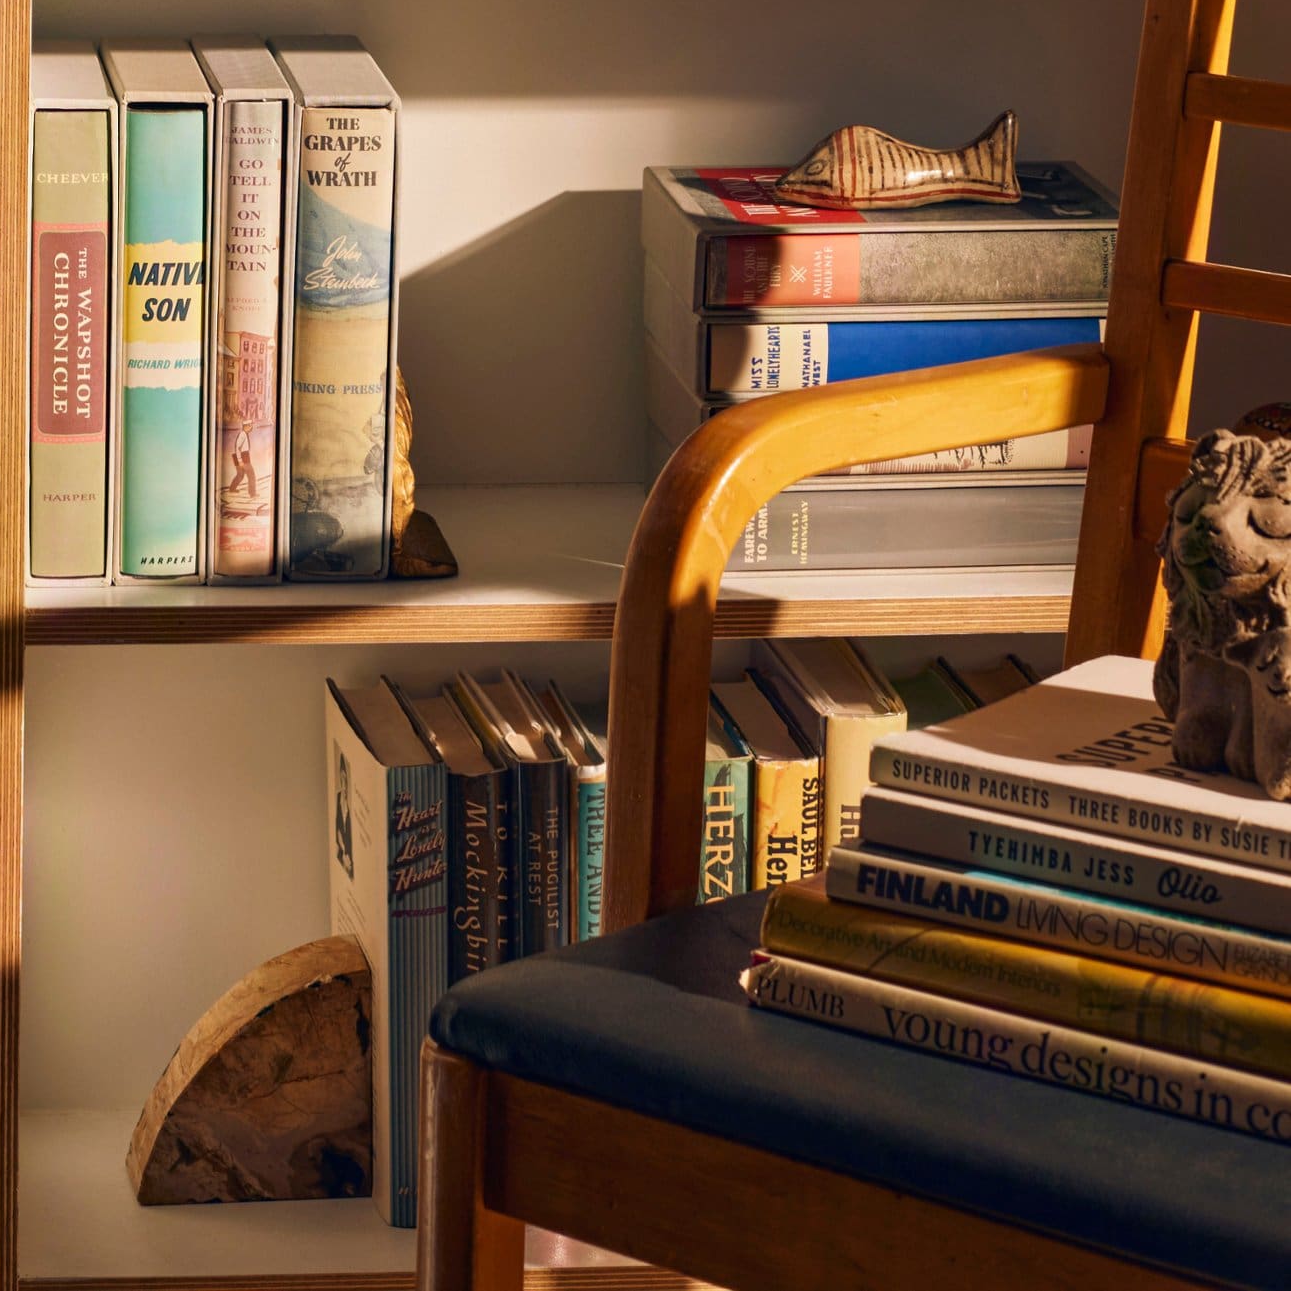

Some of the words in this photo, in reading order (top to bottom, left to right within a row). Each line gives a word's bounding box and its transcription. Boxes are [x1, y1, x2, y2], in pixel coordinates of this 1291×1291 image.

[231, 127, 273, 135] JAMES
[326, 118, 360, 131] THE
[304, 134, 382, 152] GRAPES
[239, 159, 263, 169] GO
[334, 153, 353, 170] of
[37, 173, 108, 184] CHEEVER
[229, 176, 272, 186] TELL
[307, 171, 377, 188] WRATH
[242, 193, 259, 204] IT
[237, 210, 261, 221] ON
[232, 227, 266, 238] THE
[77, 247, 89, 279] THE
[227, 261, 267, 272] TAIN
[326, 235, 364, 269] John
[303, 267, 383, 292] Steinbeck
[813, 250, 823, 296] WILLIAM
[823, 246, 834, 299] FAULKNER
[142, 298, 191, 322] SON
[52, 252, 69, 415] CHRONICLE
[76, 287, 93, 418] WAPSHOT
[767, 326, 781, 389] LONELYHEARTS
[294, 383, 336, 395] VIKING
[342, 382, 383, 395] PRESS
[751, 357, 763, 389] MISS
[43, 493, 97, 502] HARPER
[791, 512, 799, 554] ERNEST
[800, 500, 808, 564] HEMINGWAY
[140, 555, 193, 566] HARPERS
[396, 800, 443, 832] Heart
[496, 801, 508, 840] TO
[802, 777, 822, 834] SAUL
[892, 759, 970, 794] SUPERIOR
[979, 776, 1050, 810] PACKETS
[1069, 794, 1119, 824] THREE
[1129, 808, 1183, 838] BOOKS
[1192, 822, 1212, 843] BY
[1221, 826, 1270, 855] SUSIE
[546, 807, 559, 839] THE
[398, 826, 447, 862] Lonely
[528, 832, 541, 856] AT
[968, 830, 1072, 874] TYEHIMBA
[1084, 856, 1135, 885] JESS
[1157, 868, 1224, 905] Olio
[528, 865, 541, 906] REST
[546, 851, 559, 929] PUGILIST
[495, 868, 509, 950] KILL
[856, 863, 1010, 922] FINLAND
[1016, 897, 1110, 947] LIVING
[1114, 917, 1229, 972] DESIGN
[755, 975, 846, 1019] PLUMB
[1021, 1030, 1185, 1111] designs
[1193, 1071, 1234, 1131] in
